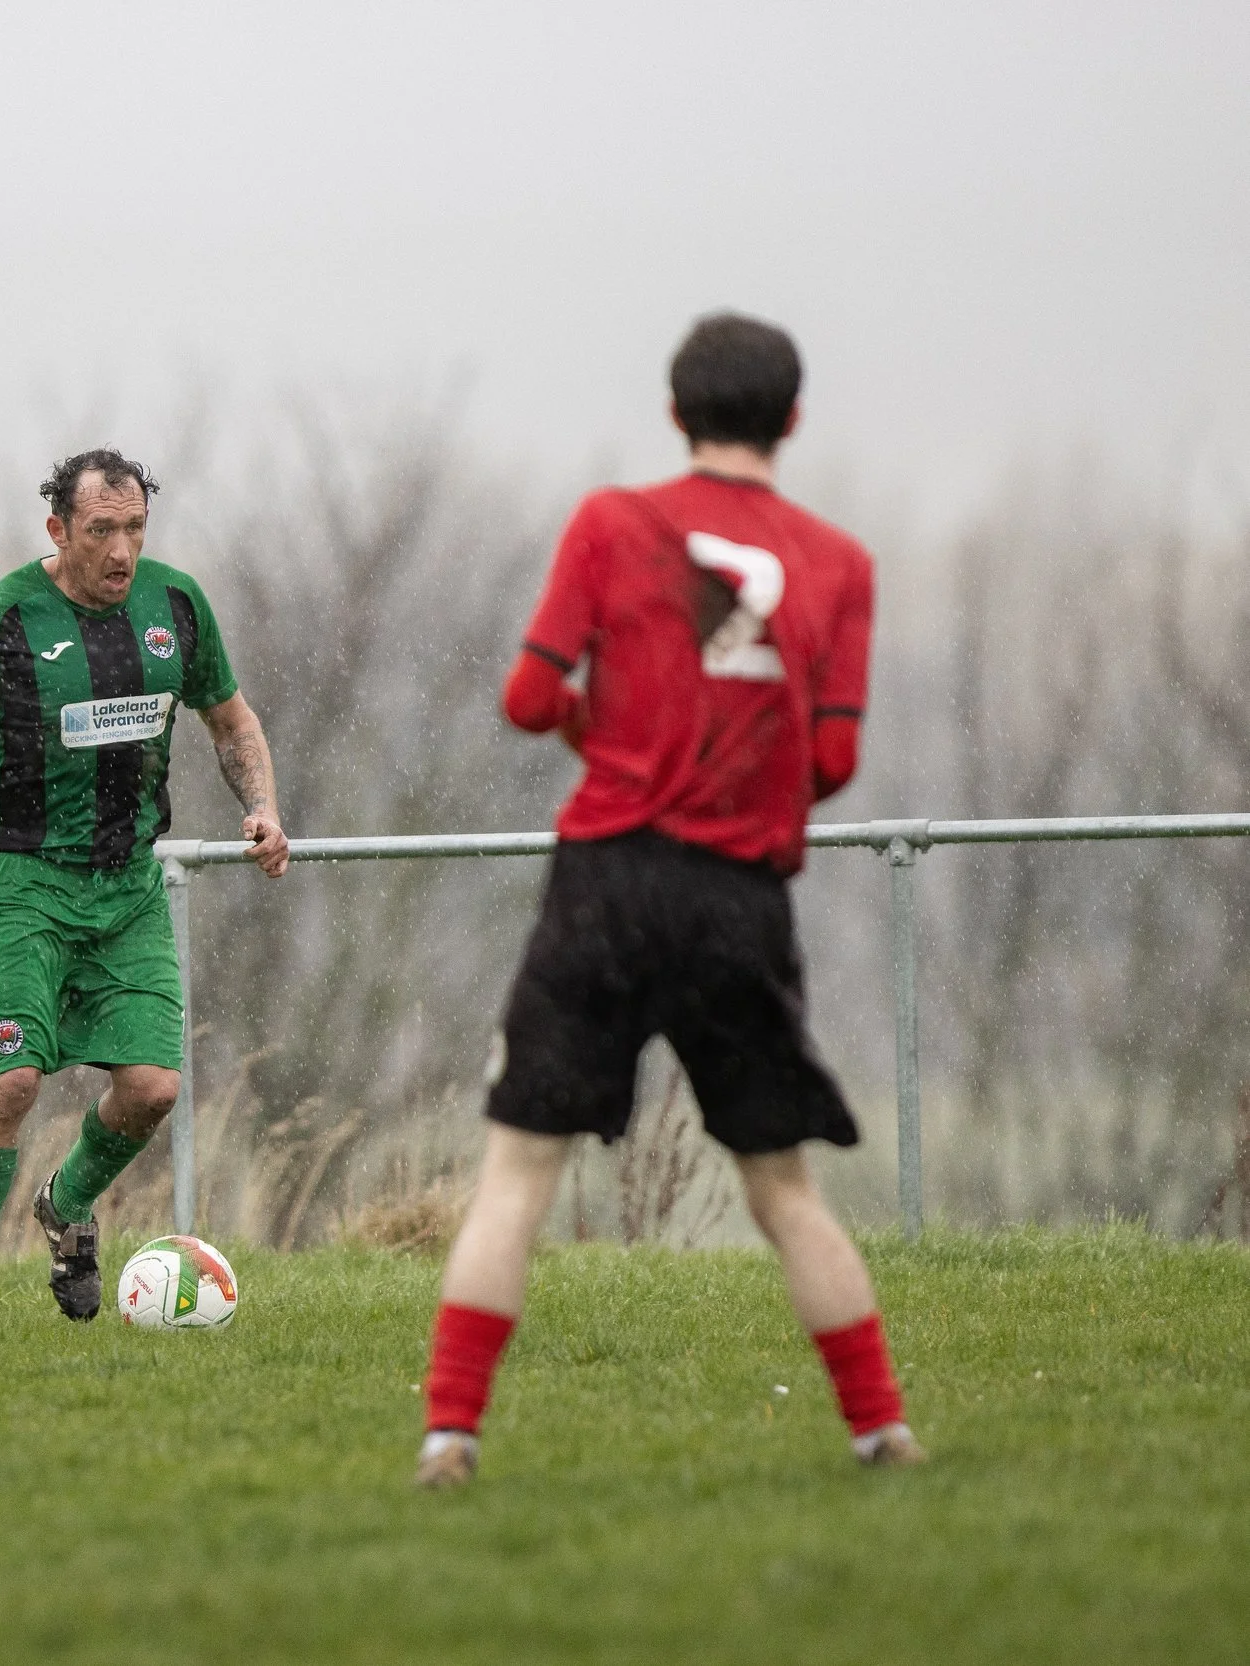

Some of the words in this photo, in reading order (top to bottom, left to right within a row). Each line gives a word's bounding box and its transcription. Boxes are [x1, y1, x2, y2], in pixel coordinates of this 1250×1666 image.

[686, 530, 787, 683] 2
[92, 698, 159, 717] Lakeland
[65, 733, 98, 743] DECKING
[102, 729, 132, 740] FENCING
